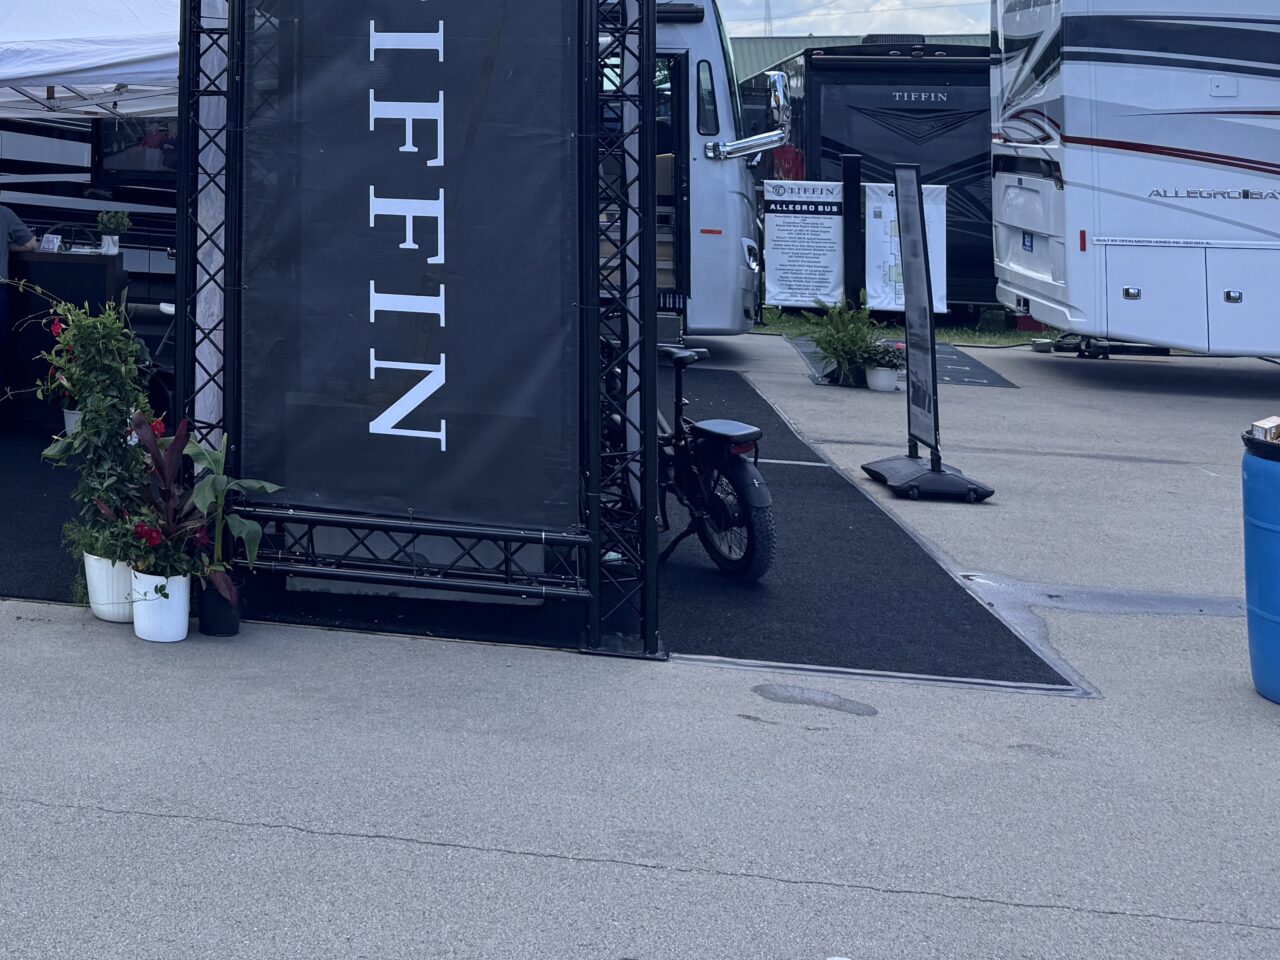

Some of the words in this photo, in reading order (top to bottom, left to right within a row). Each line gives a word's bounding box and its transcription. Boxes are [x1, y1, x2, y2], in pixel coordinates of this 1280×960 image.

[892, 91, 948, 102] TIFFIN
[788, 187, 834, 195] TIFFIN
[1148, 187, 1241, 200] ALLEGRO
